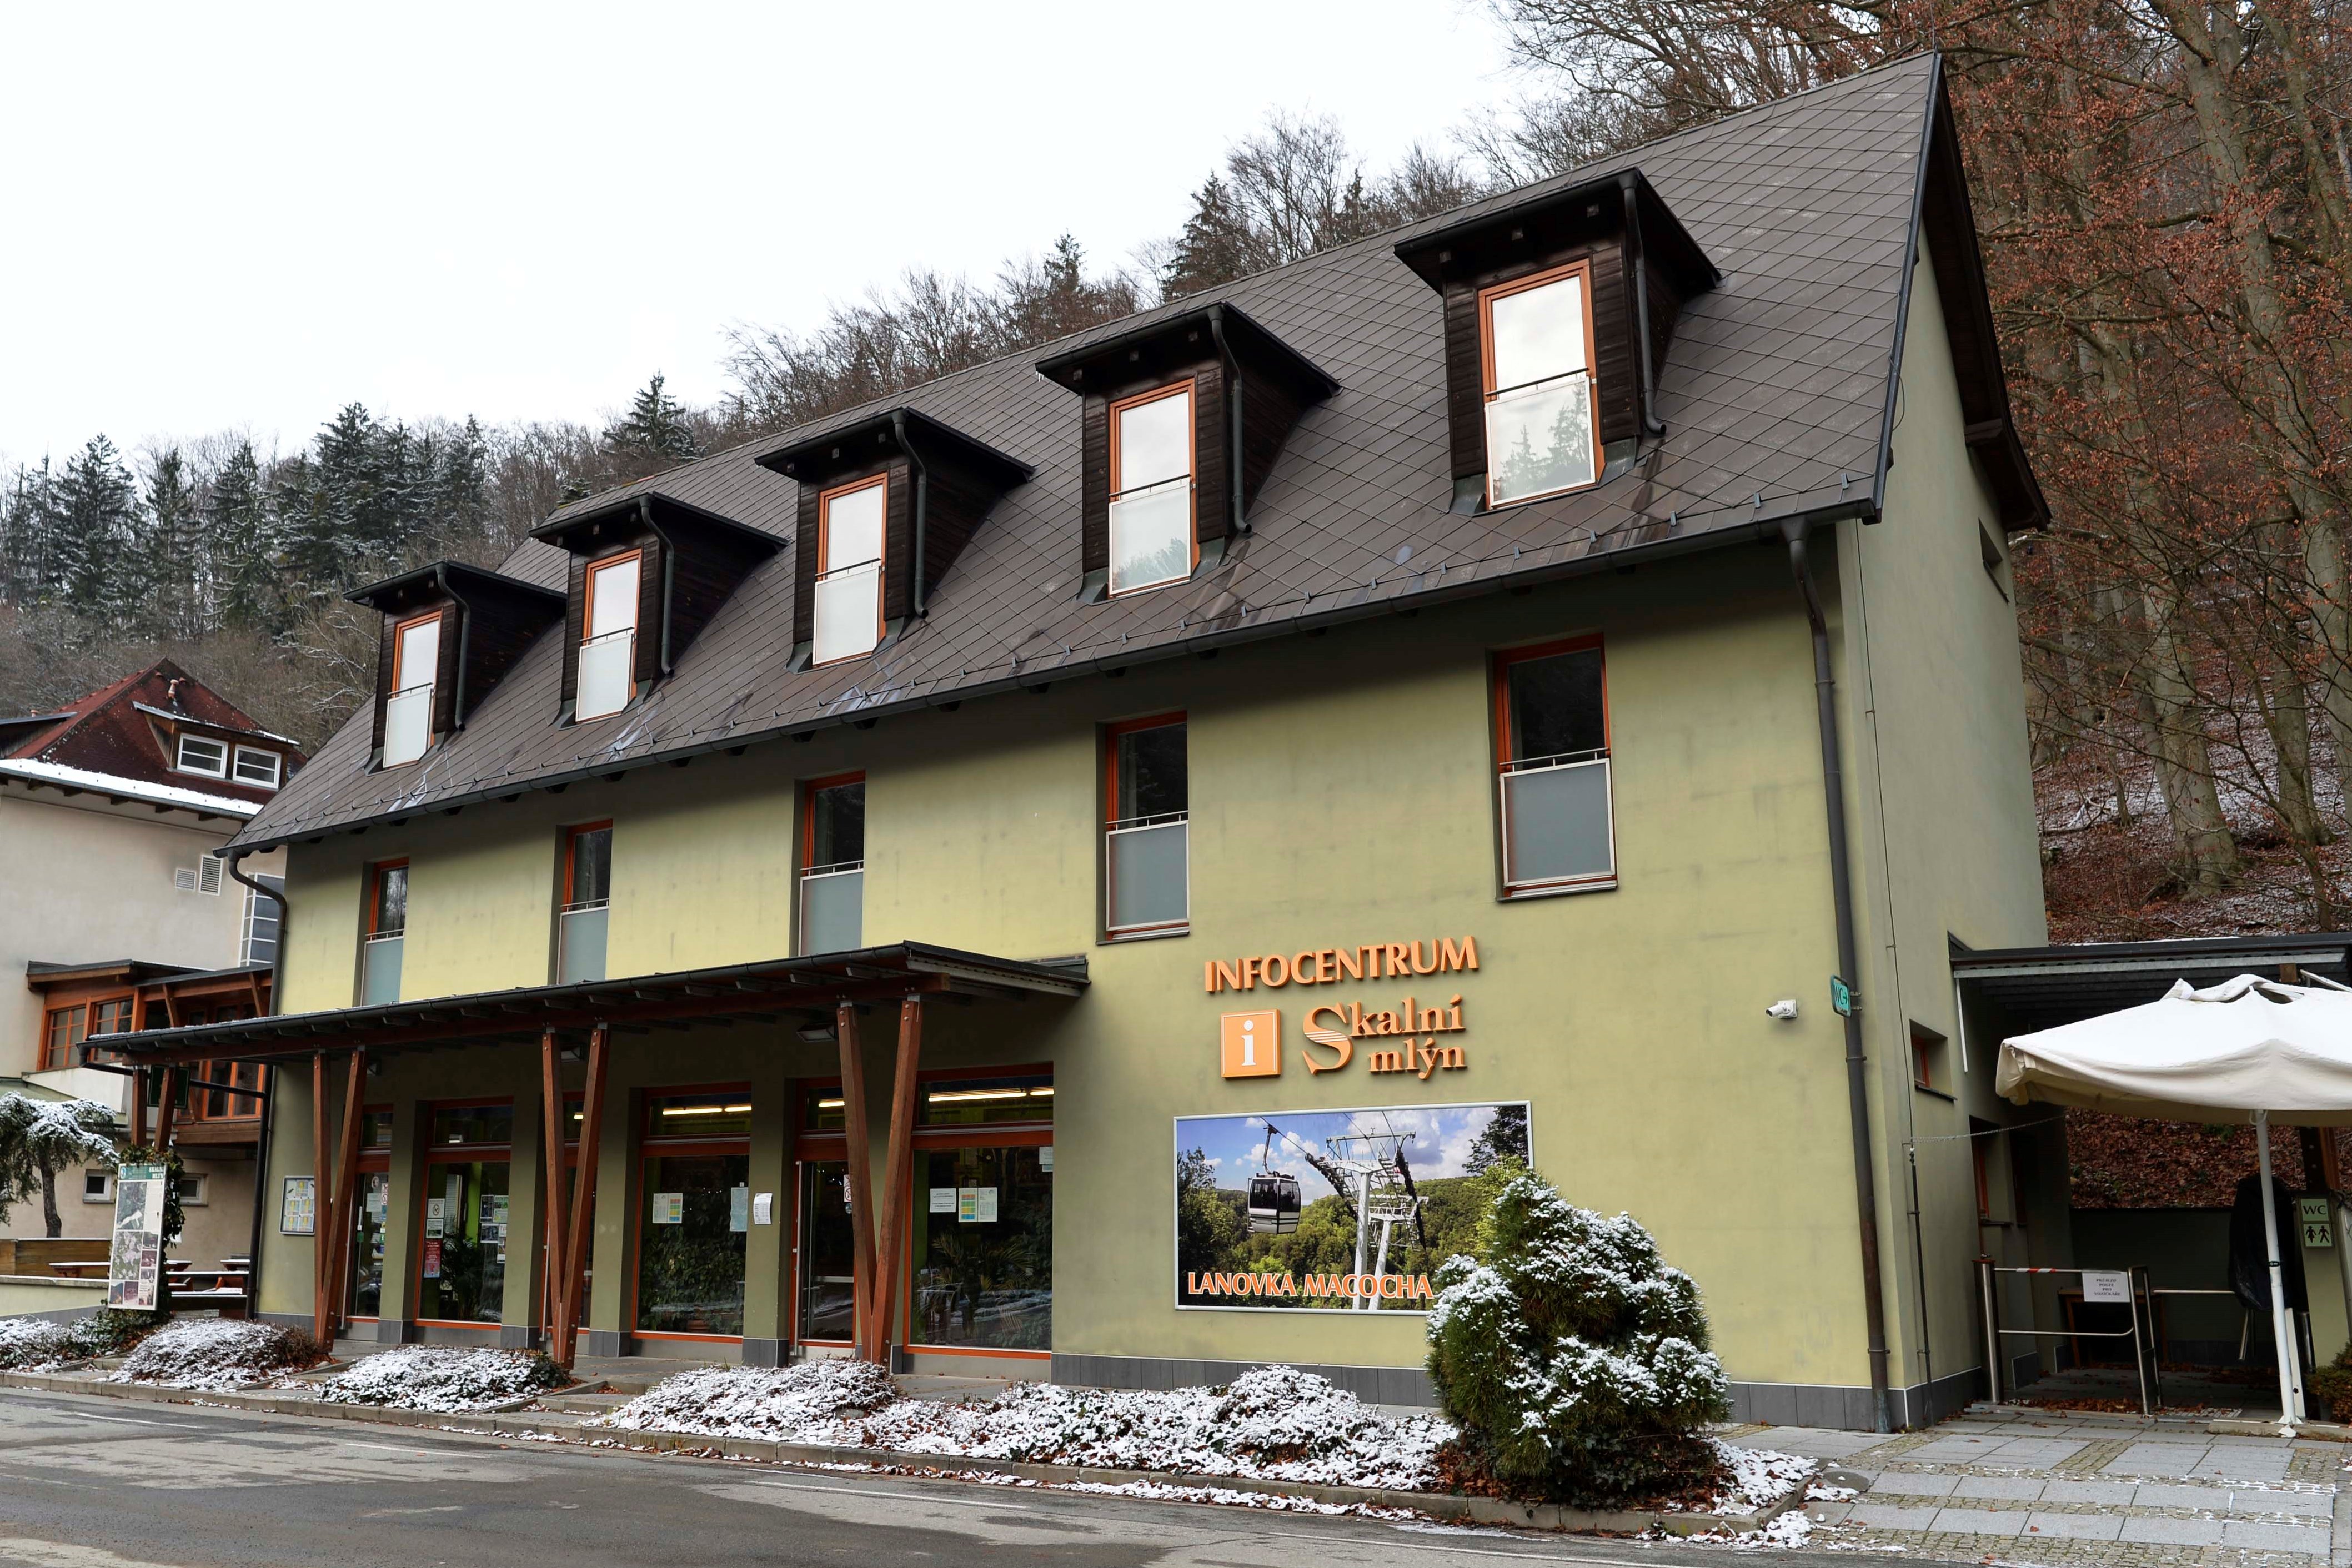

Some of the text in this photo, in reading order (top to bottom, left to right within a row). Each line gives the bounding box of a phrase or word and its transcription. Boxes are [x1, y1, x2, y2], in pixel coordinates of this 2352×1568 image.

[1204, 936, 1480, 993] INFOCENTRUM
[1302, 994, 1466, 1076] Skalní
[1368, 1037, 1468, 1080] mlýn
[2303, 1205, 2327, 1215] WC
[1188, 1272, 1435, 1299] LANOVKA MACOCHA
